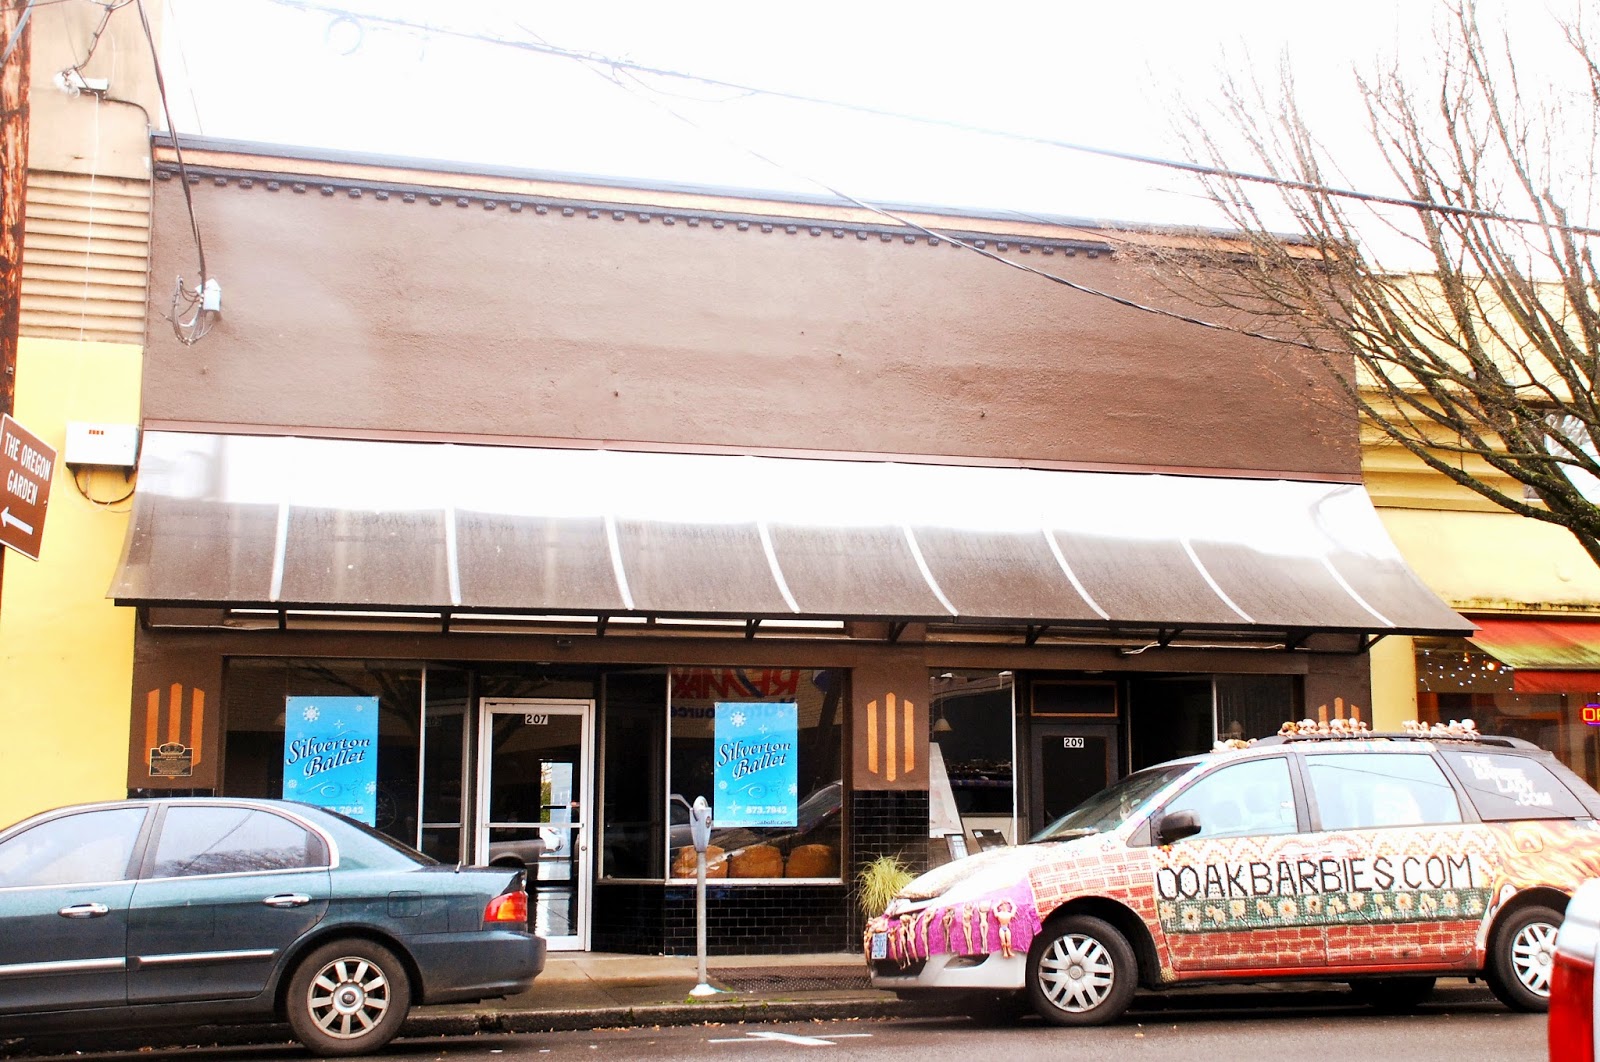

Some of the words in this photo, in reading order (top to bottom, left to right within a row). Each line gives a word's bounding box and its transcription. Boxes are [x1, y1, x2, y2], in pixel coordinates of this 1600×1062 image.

[4, 432, 21, 461] THE
[21, 444, 52, 481] OREGON
[7, 469, 39, 506] GARDEN
[526, 714, 547, 724] 207
[286, 737, 371, 766] Silverton
[716, 740, 791, 767] Silverton
[1064, 738, 1083, 748] 209
[303, 748, 366, 778] Ballet
[732, 751, 787, 780] Ballet
[1496, 777, 1534, 793] LADY
[1515, 792, 1553, 806] .COM
[1156, 854, 1475, 901] OOAKBARBIES.COM
